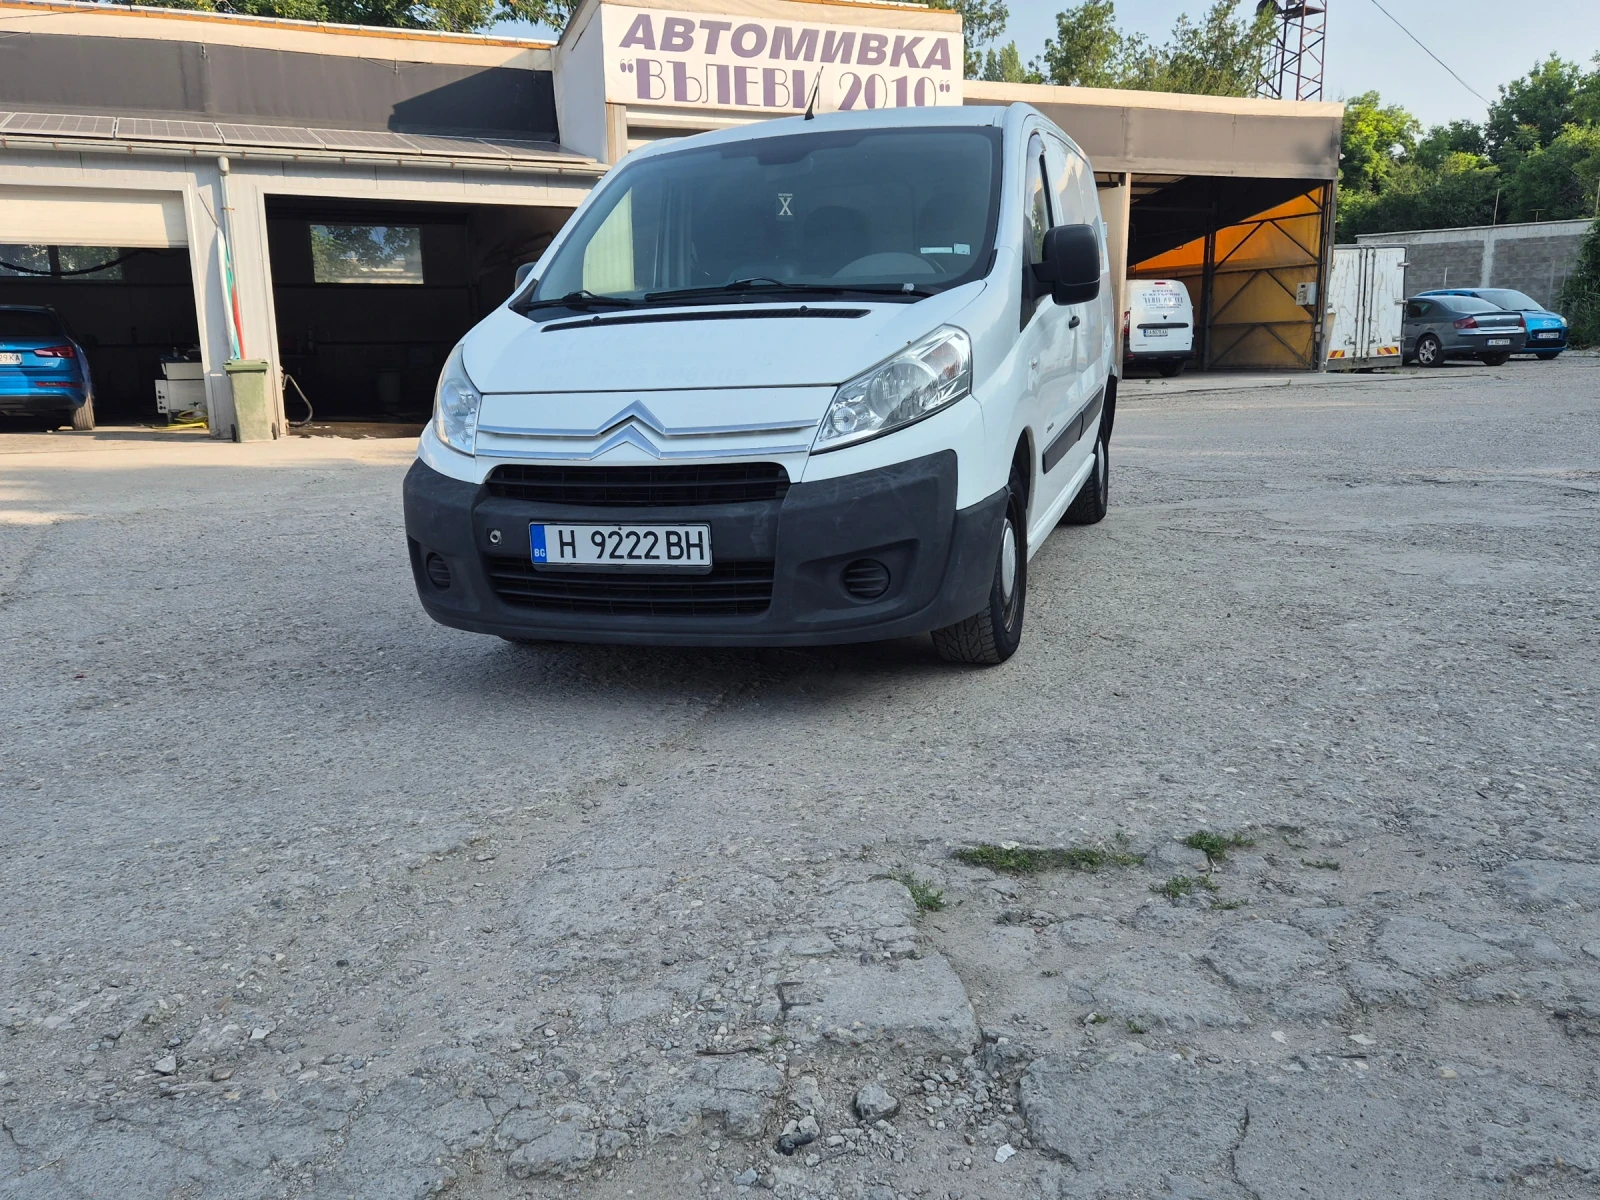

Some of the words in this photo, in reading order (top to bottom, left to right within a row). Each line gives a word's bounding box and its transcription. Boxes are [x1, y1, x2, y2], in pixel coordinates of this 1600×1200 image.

[619, 12, 952, 71] АВТОМИВКА
[534, 548, 546, 557] BG
[558, 529, 577, 559] H
